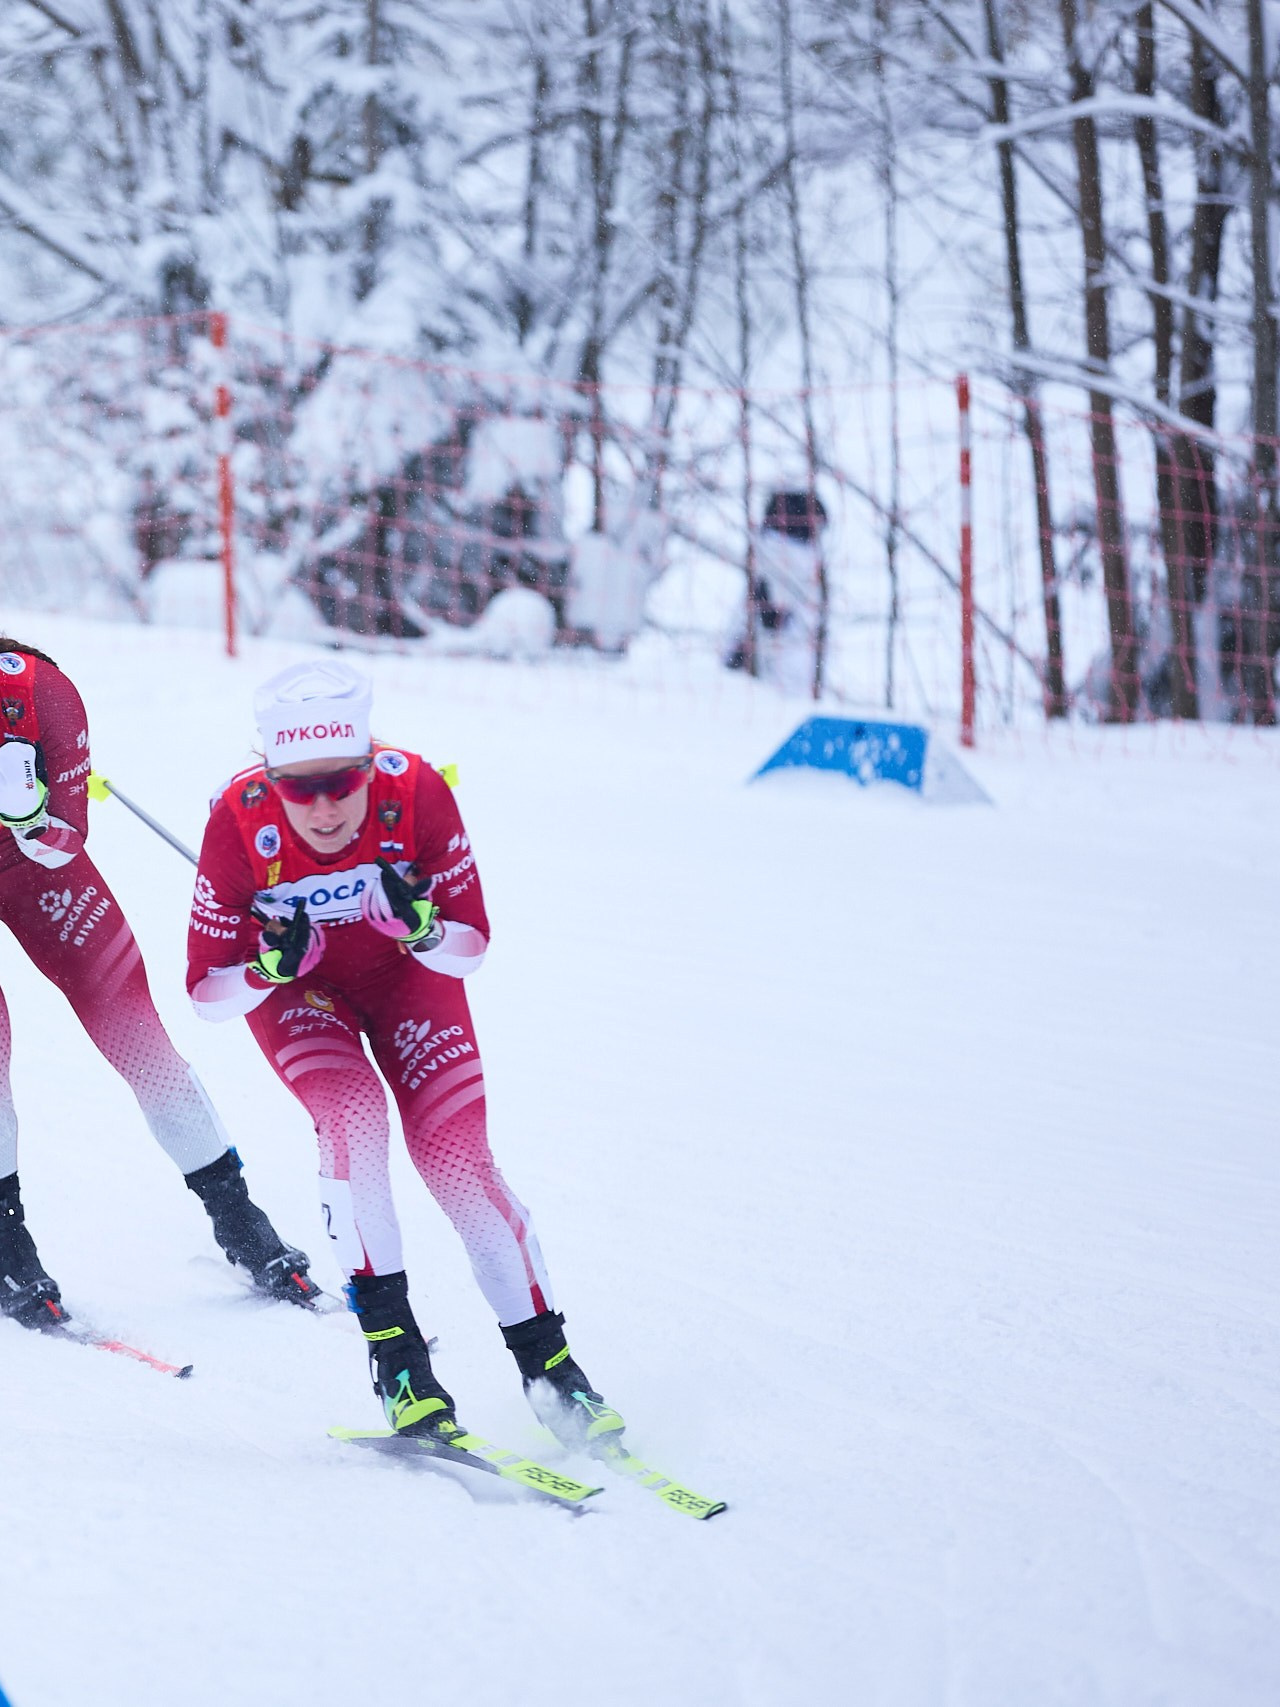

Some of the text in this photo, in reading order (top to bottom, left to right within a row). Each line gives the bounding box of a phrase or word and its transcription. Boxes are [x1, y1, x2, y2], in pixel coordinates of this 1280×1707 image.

[275, 721, 355, 746] ЛУКОЙЛ
[431, 853, 476, 884] ЛУКО
[59, 886, 97, 942] ФОСАГРО
[73, 897, 111, 947] BIVIUM
[401, 1025, 464, 1085] ФОСАГРО
[409, 1041, 475, 1090] BIVIUM
